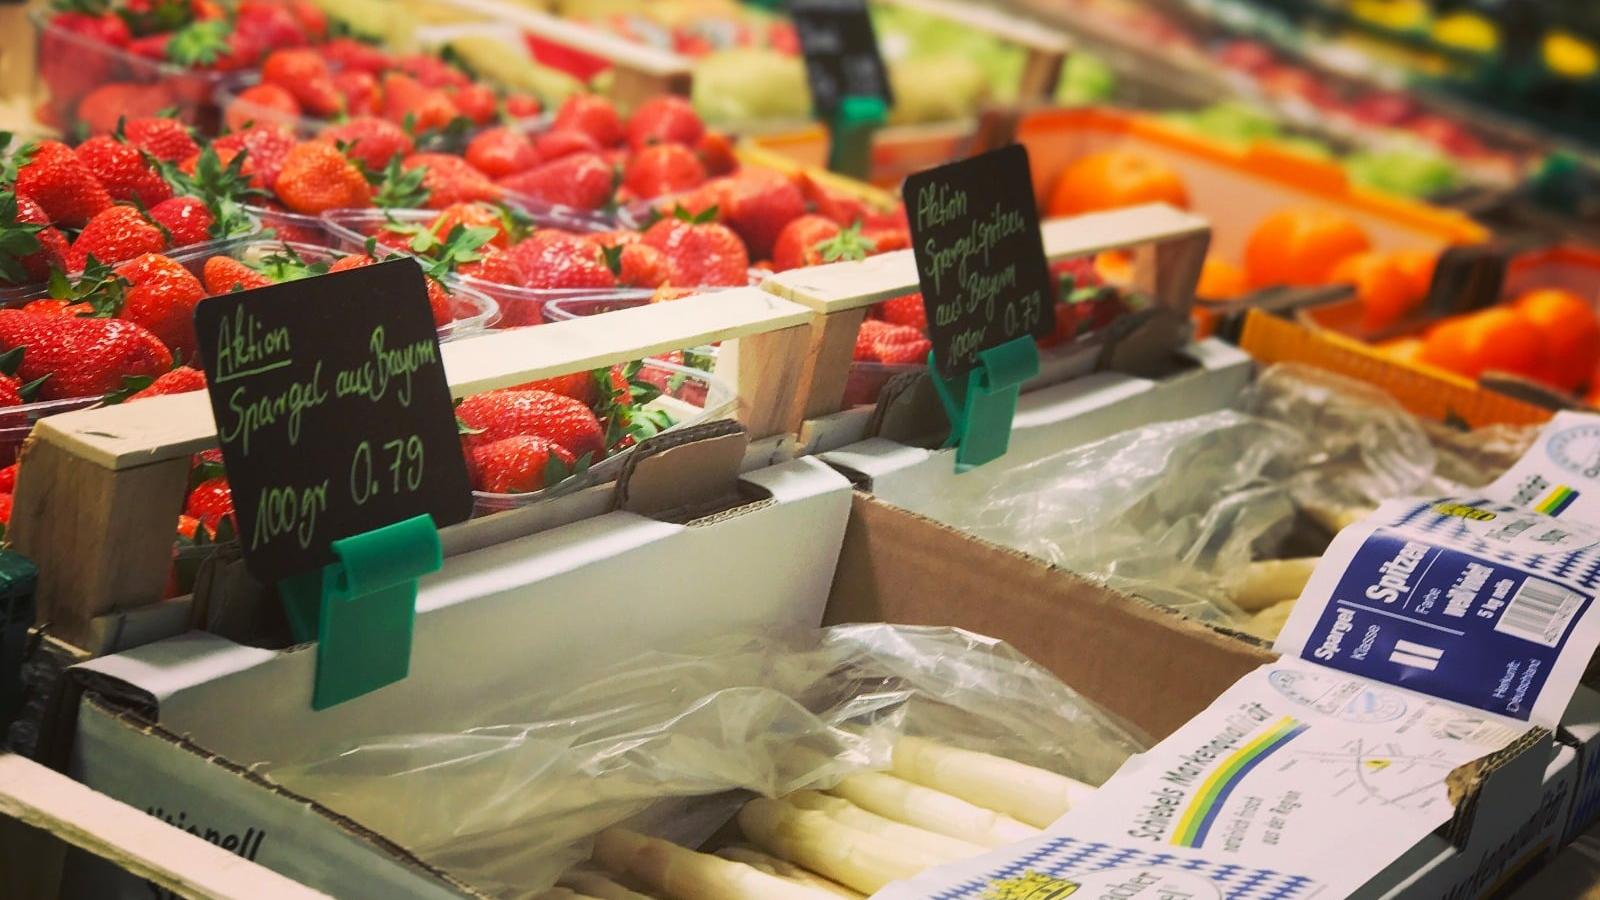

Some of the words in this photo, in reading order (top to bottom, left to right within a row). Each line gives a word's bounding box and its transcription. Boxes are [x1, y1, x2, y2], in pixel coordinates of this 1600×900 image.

[917, 182, 968, 232] Aktion
[935, 294, 963, 327] aus
[1004, 290, 1042, 336] 0.79
[216, 302, 291, 373] Aktion
[220, 359, 329, 456] Spargel
[335, 361, 373, 398] aus
[251, 479, 329, 549] 100gr
[350, 434, 424, 506] 0.79
[1476, 608, 1494, 619] 5
[1480, 597, 1505, 612] kg
[1314, 606, 1356, 661] Spargel
[1351, 623, 1381, 661] Klasse
[1388, 638, 1446, 671] II
